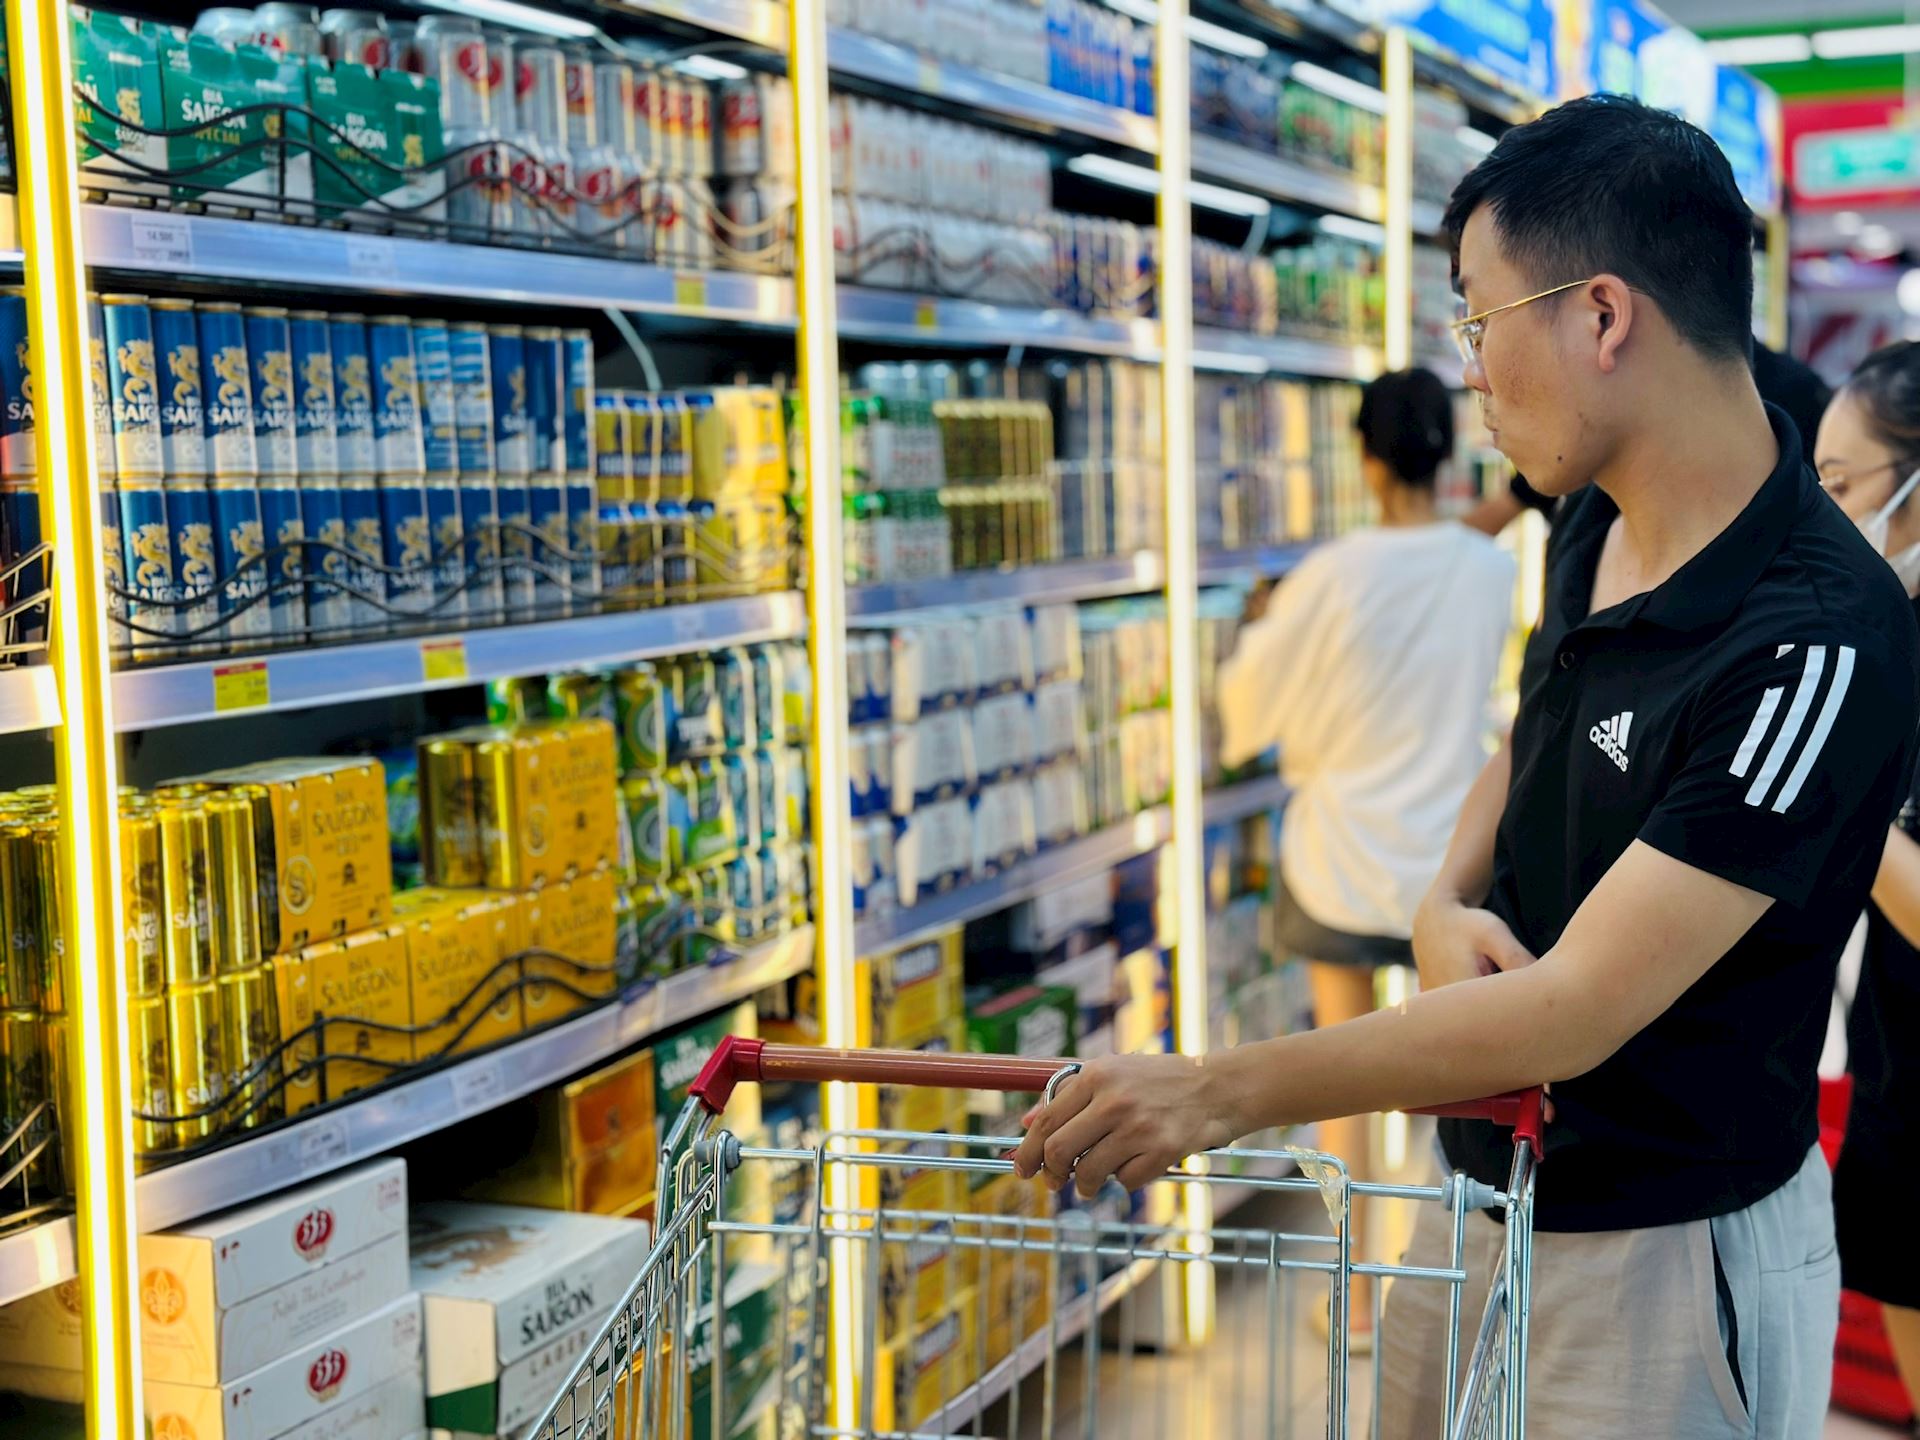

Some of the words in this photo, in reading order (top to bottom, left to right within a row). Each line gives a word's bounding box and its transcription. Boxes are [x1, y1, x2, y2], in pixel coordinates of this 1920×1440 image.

[181, 98, 248, 129] SAIGON
[1589, 725, 1629, 772] adidas
[521, 1283, 594, 1346] SAIGON
[529, 1329, 590, 1377] LAGER
